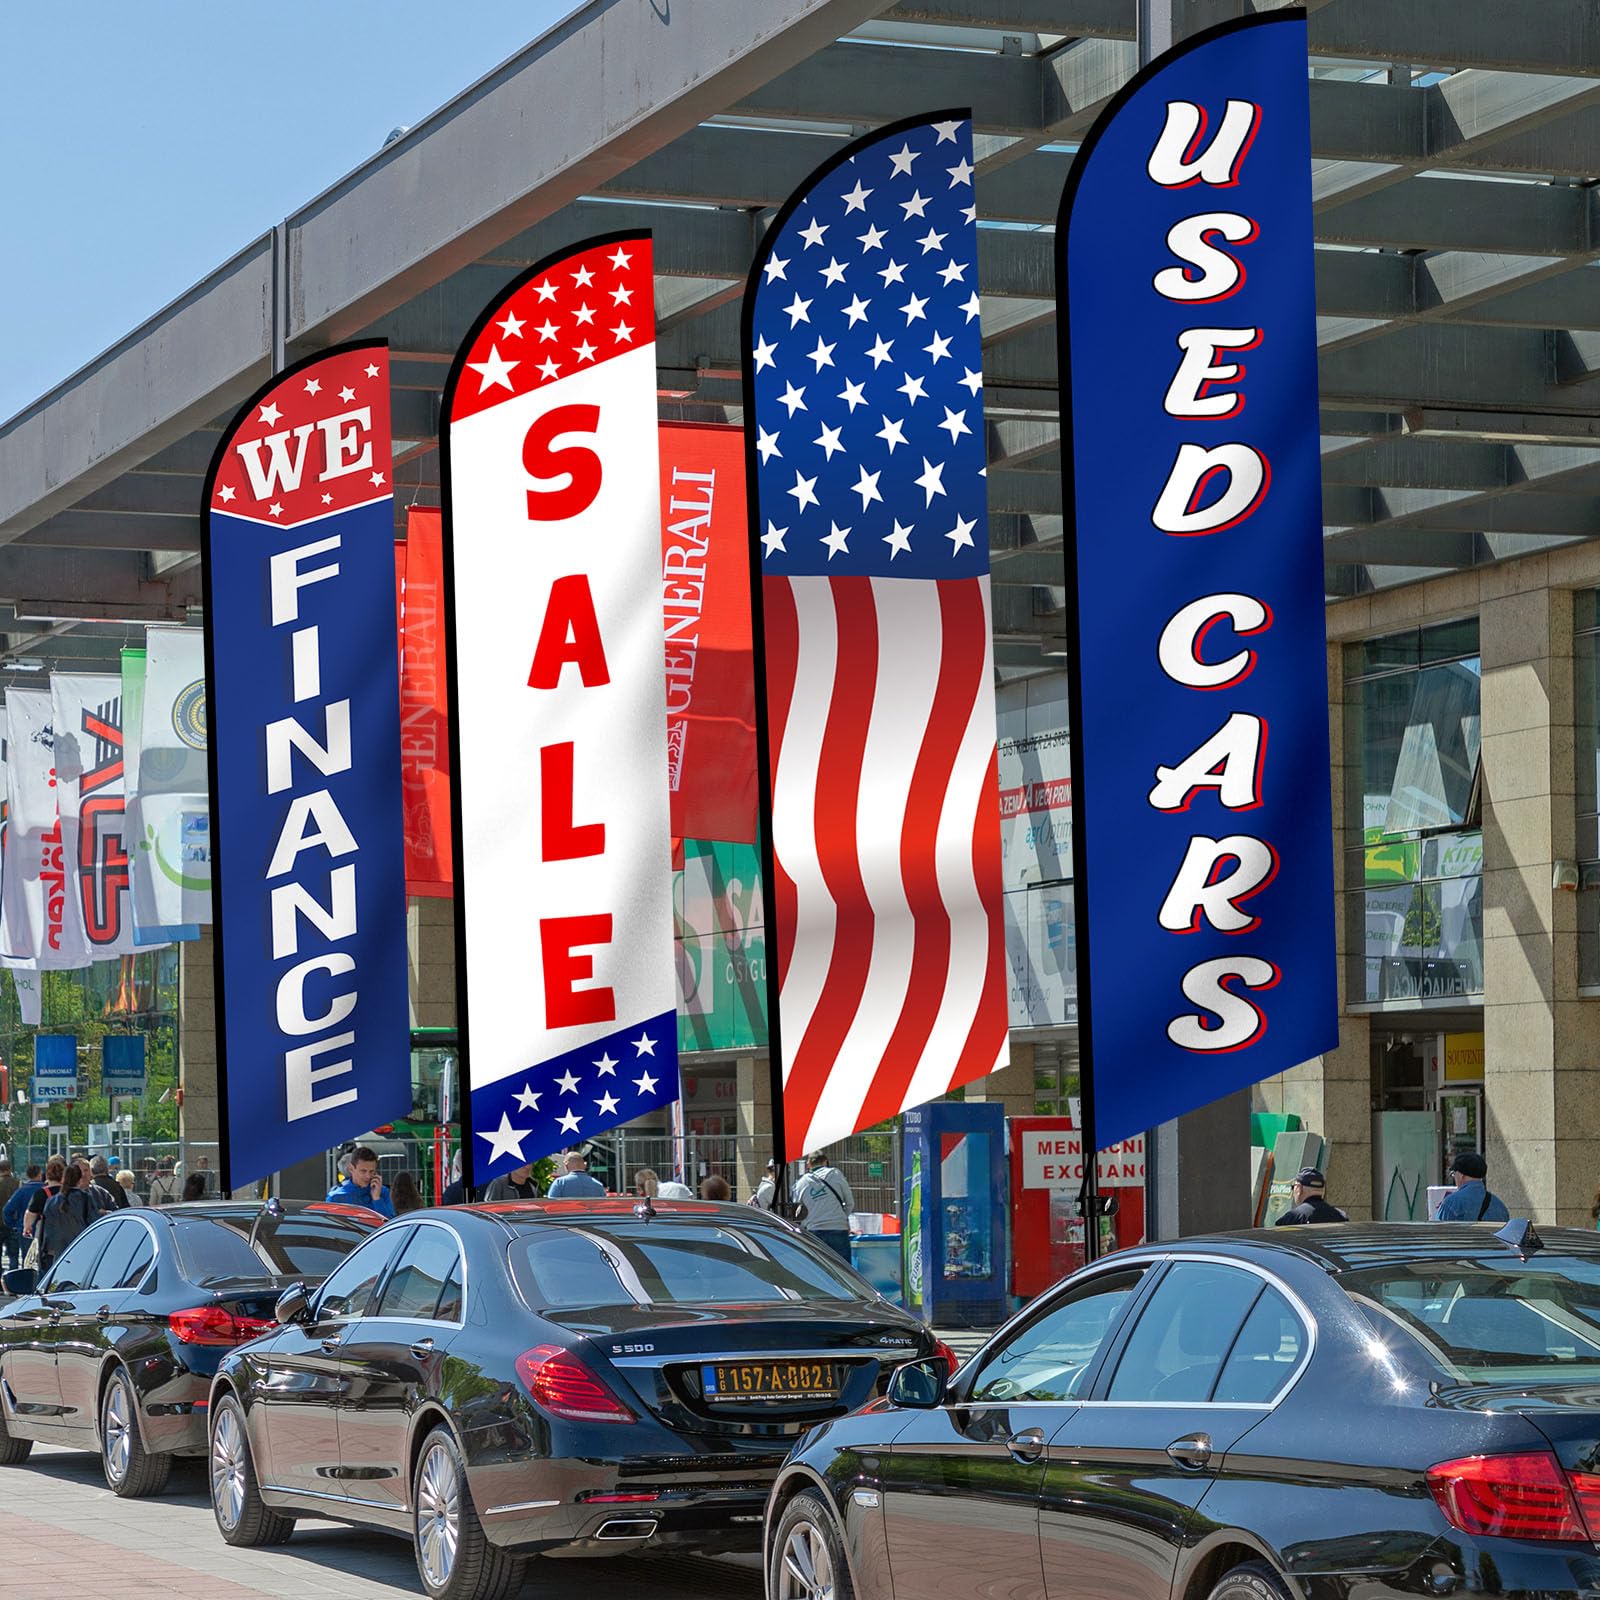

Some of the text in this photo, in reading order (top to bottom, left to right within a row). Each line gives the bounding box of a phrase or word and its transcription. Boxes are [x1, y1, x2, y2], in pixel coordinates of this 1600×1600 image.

[236, 405, 373, 502] WE
[1147, 98, 1282, 1054] USED CARS
[662, 466, 715, 715] GENERALI
[265, 534, 359, 1122] FINANCE
[522, 403, 616, 1029] SALE
[38, 1086, 67, 1096] ERSTE
[612, 1343, 655, 1353] S 500
